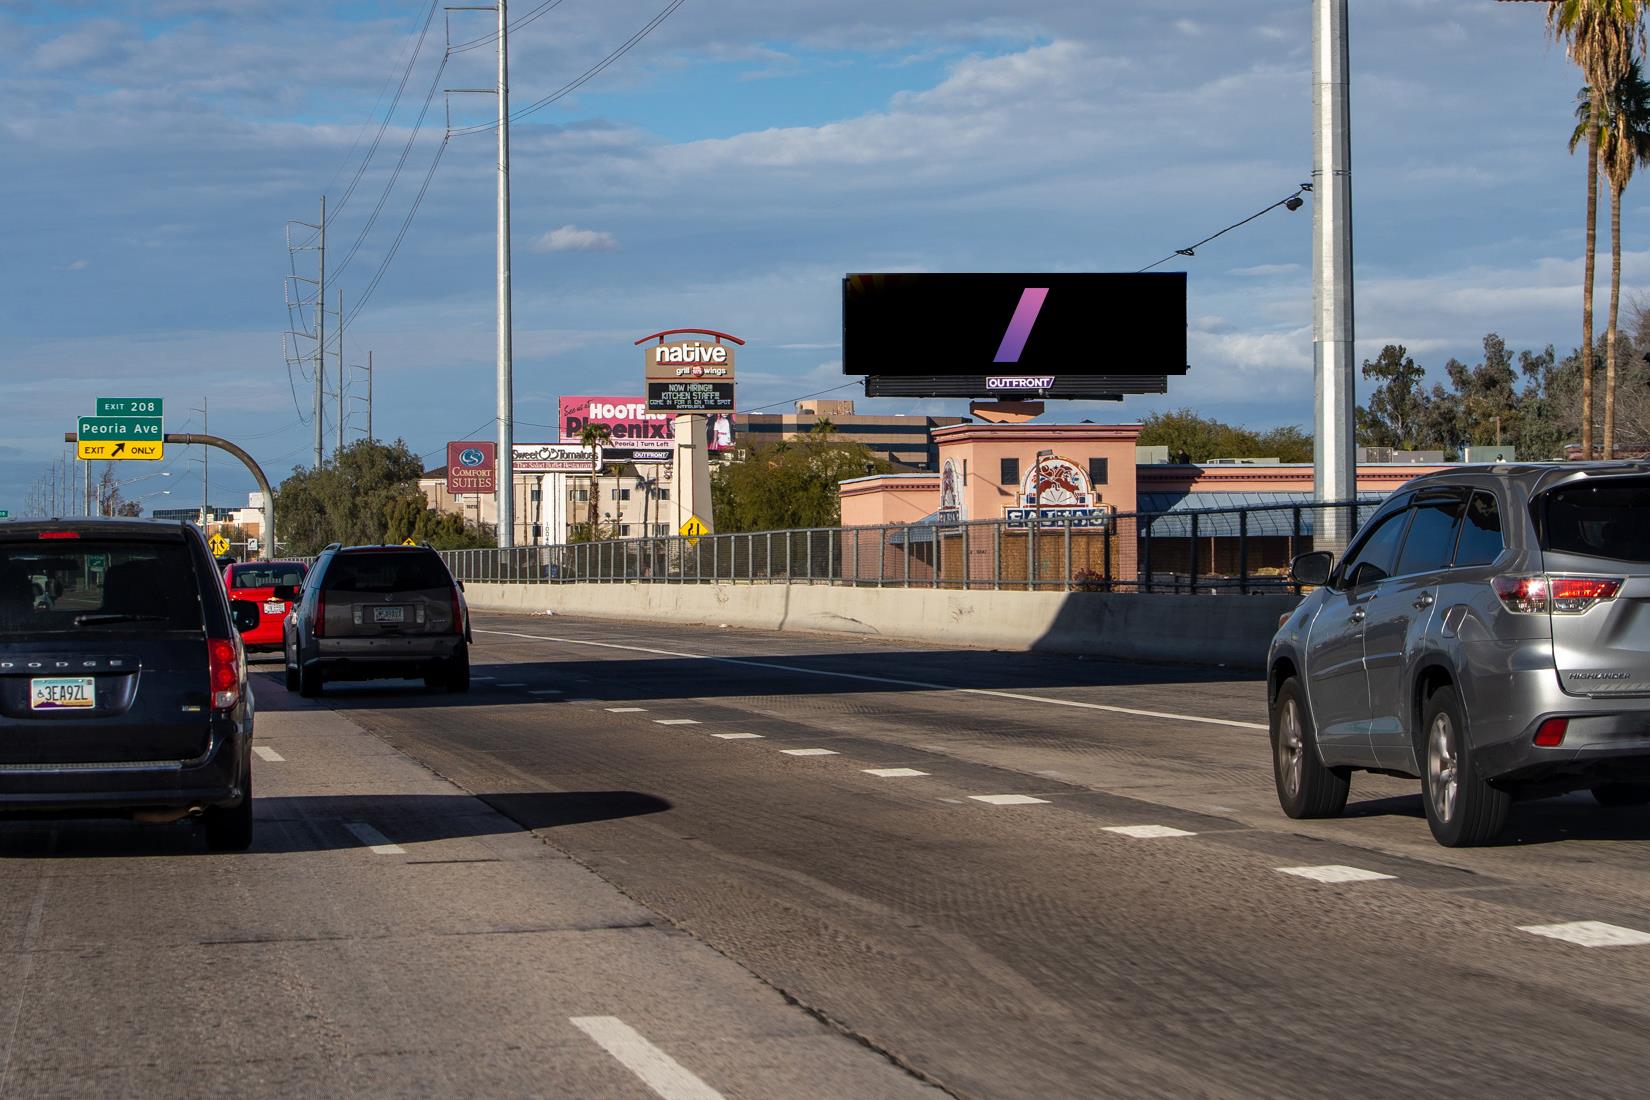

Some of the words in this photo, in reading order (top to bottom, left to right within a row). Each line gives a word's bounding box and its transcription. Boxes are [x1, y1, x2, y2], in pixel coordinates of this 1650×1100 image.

[655, 342, 727, 362] native
[676, 367, 690, 375] grill
[704, 367, 727, 375] wings
[989, 378, 1050, 387] OUTFRONT
[668, 384, 685, 392] NOW
[661, 392, 690, 400] KITCHEN
[130, 402, 155, 412] 208
[589, 403, 667, 419] HOOTE
[82, 423, 127, 434] Peoria
[134, 423, 159, 434] Ave
[84, 446, 105, 454] EXIT
[131, 446, 156, 455] ONLY
[512, 449, 539, 460] Sweet
[452, 478, 492, 488] SUITES
[1, 660, 123, 668] DODGE
[1568, 672, 1632, 680] HIGHLANDER
[44, 685, 89, 701] 3EA9ZL
